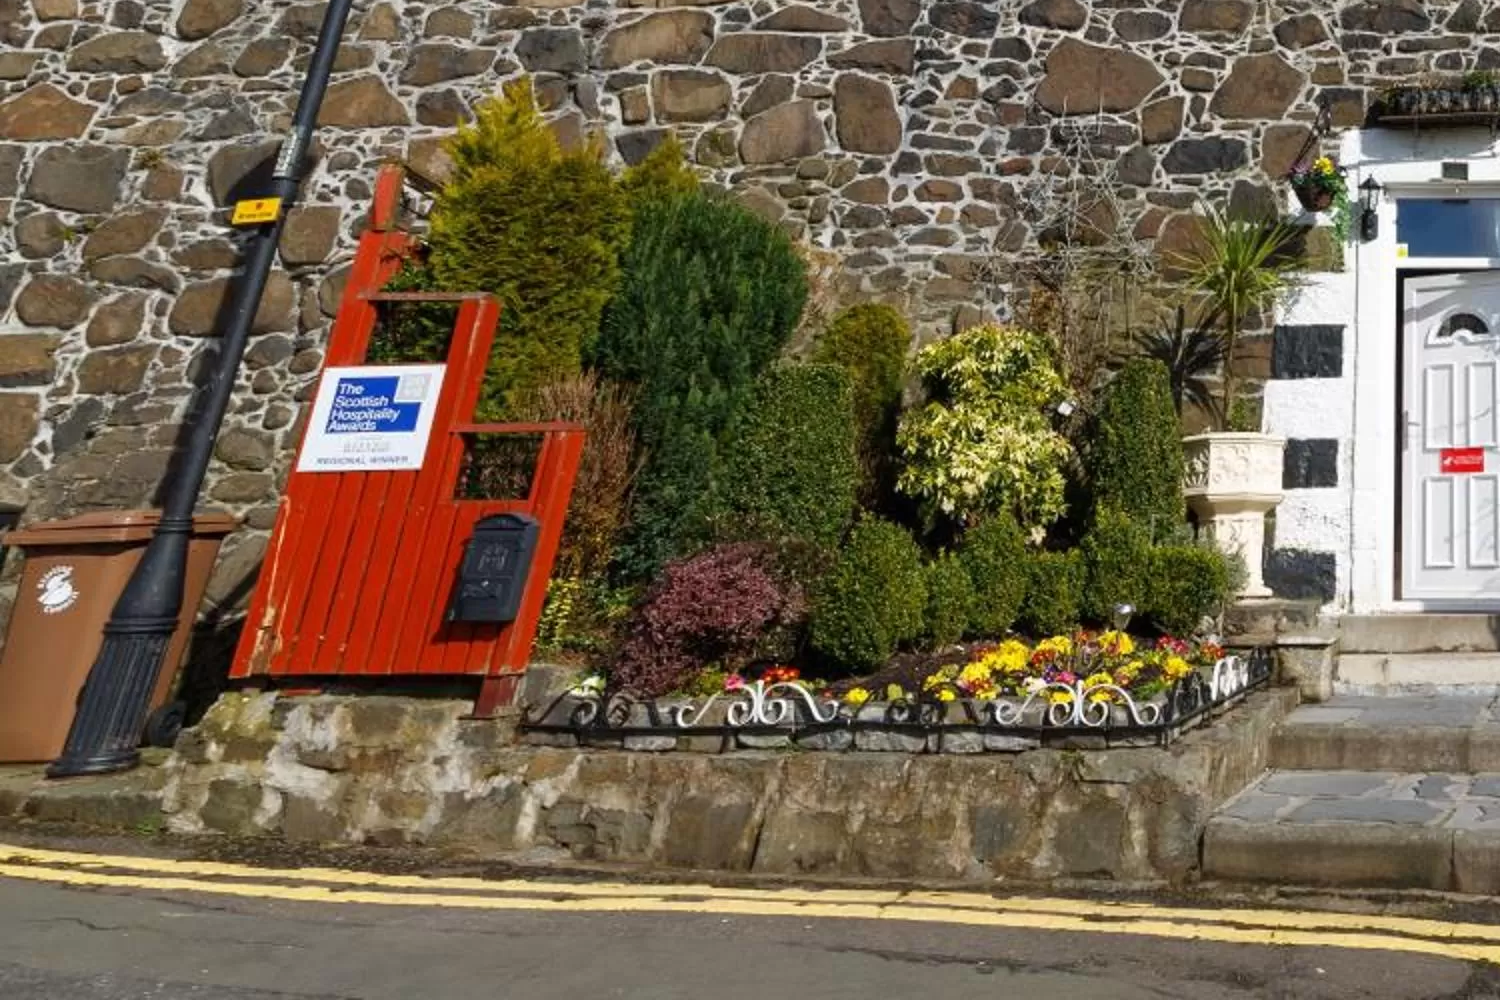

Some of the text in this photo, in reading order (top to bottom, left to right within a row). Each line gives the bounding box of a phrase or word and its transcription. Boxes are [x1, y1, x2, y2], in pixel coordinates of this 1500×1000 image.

[340, 384, 364, 395] The
[335, 395, 389, 408] Scottish
[331, 408, 401, 423] Hospitality
[328, 420, 377, 432] Awards
